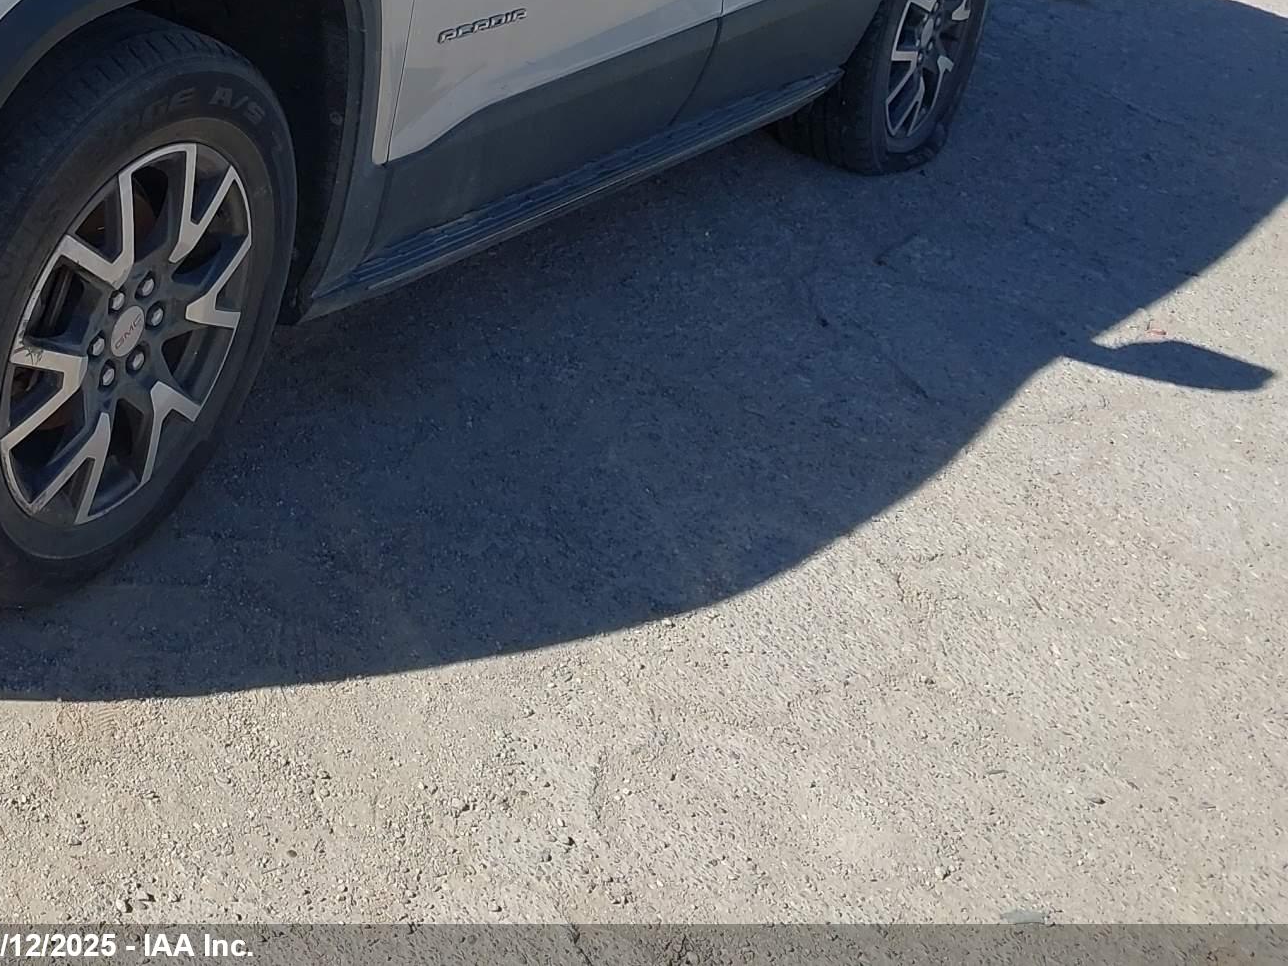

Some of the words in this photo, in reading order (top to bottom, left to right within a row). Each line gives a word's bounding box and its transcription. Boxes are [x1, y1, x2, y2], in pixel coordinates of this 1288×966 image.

[437, 7, 528, 44] ACADIA
[209, 86, 266, 125] A/S
[114, 313, 142, 350] GMC
